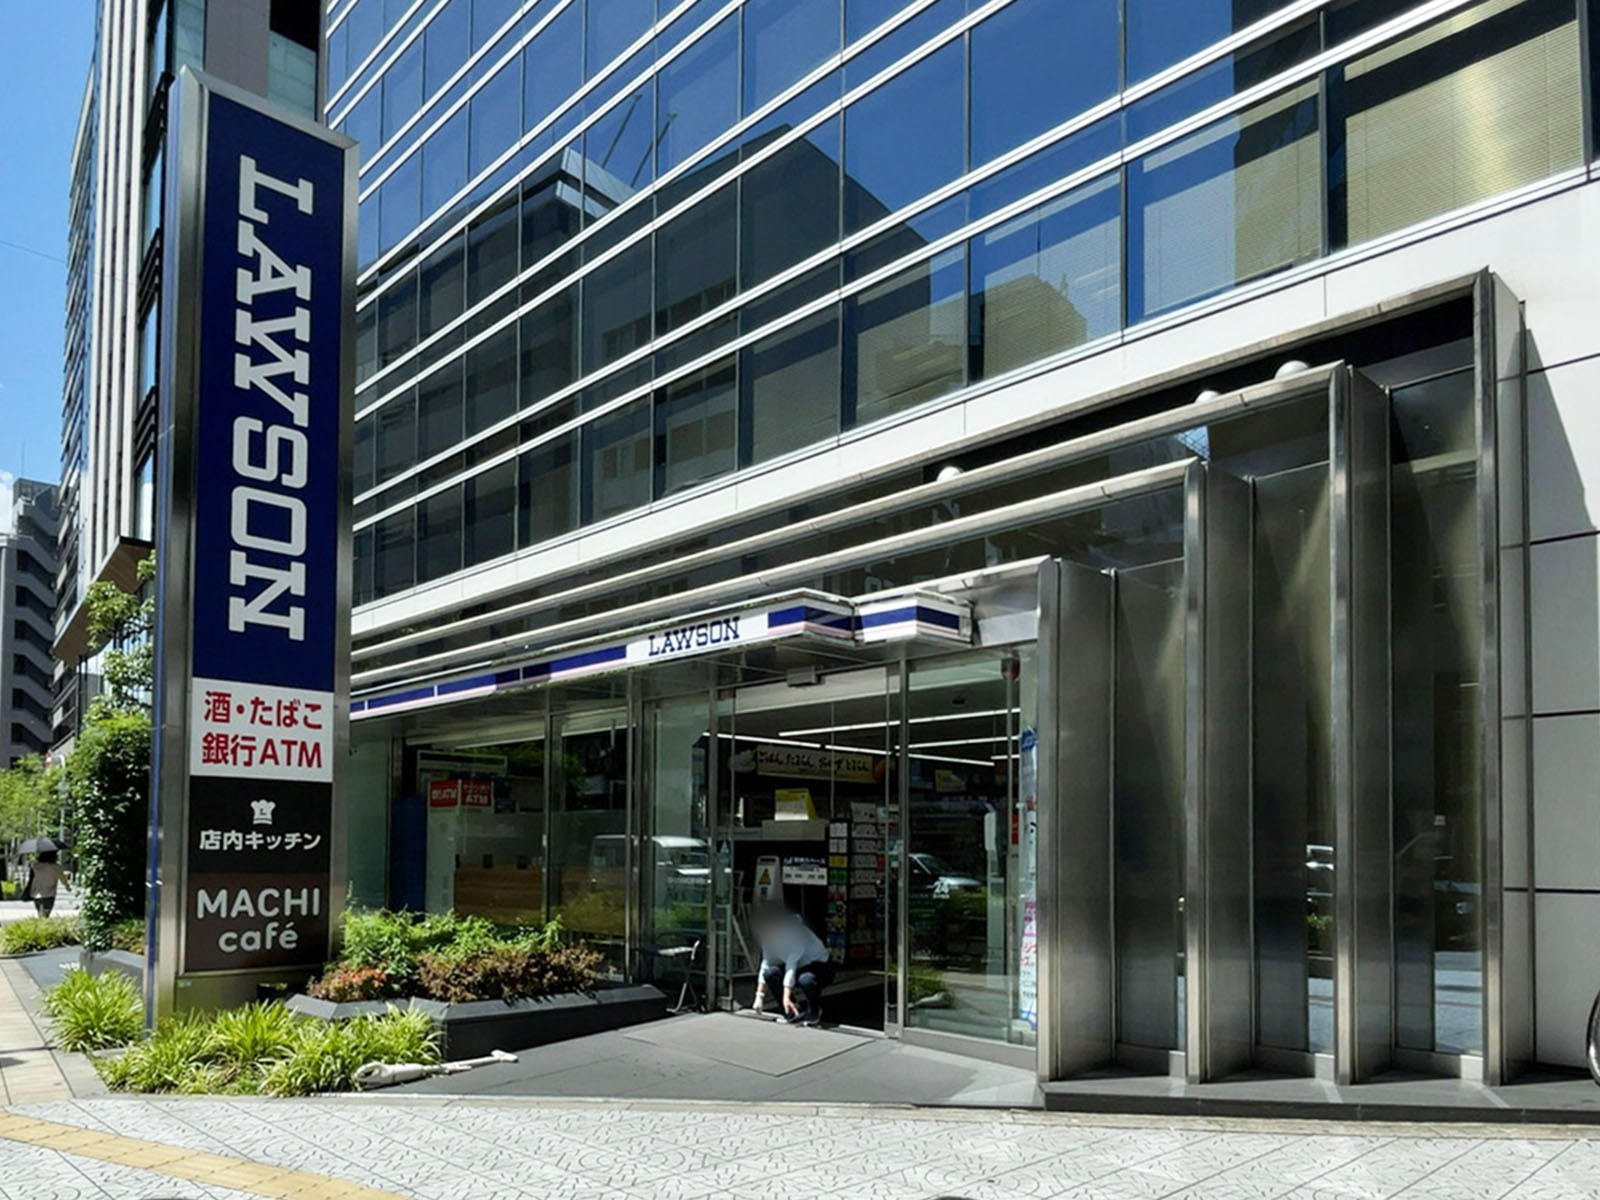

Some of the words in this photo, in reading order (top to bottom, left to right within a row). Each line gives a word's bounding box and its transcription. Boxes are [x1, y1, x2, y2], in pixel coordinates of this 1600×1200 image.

[228, 154, 314, 641] LAWSON
[648, 616, 740, 656] LAWSON
[203, 690, 323, 730] 酒・たばこ
[202, 732, 323, 768] 銀行ATM
[199, 829, 322, 851] 店内キッチン
[196, 887, 320, 919] MACHI
[218, 921, 299, 953] café
